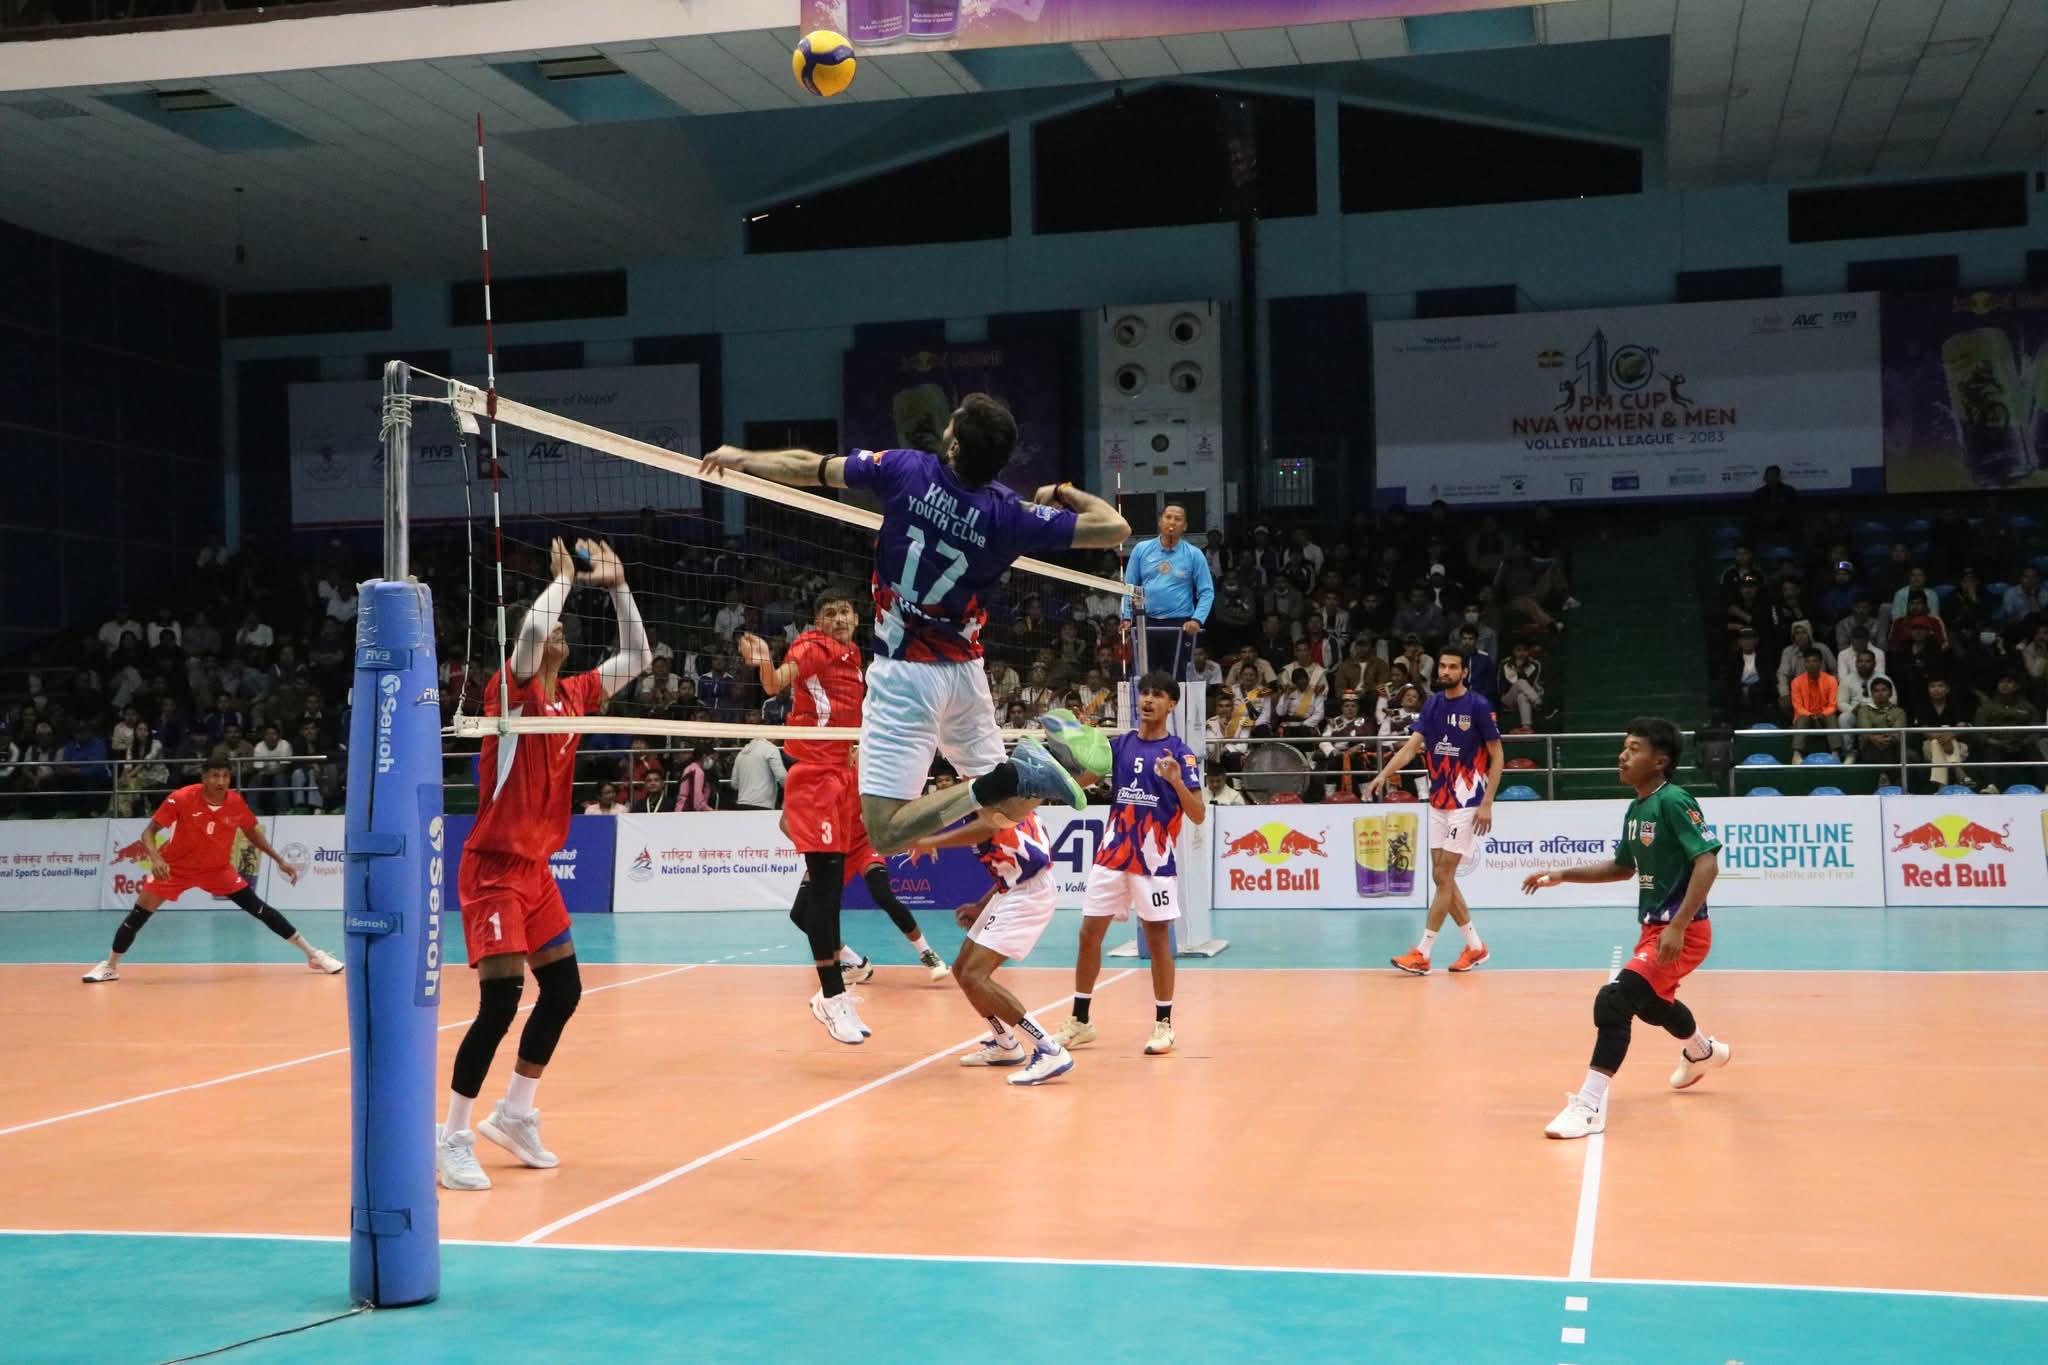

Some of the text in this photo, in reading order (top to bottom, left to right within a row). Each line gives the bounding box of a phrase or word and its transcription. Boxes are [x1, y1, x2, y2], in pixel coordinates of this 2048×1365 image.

[1580, 392, 1667, 412] PM CUP
[1512, 408, 1737, 434] NVA WOMEN & MEN
[1524, 436, 1615, 450] VOLLEYBALL
[1618, 432, 1674, 447] LEAGUE
[908, 495, 986, 548] YOUTH CLUB
[891, 524, 969, 606] 17
[1133, 757, 1145, 774] 5
[821, 821, 832, 845] 3
[1724, 823, 1854, 844] FRONTLINE
[1485, 837, 1533, 855] नेपाल
[1539, 835, 1605, 854] भलिबल
[1485, 857, 1517, 871] Nepal
[1519, 856, 1573, 871] Volleyball
[1725, 845, 1855, 868] HOSPITAL
[15, 868, 40, 879] Sports
[661, 865, 700, 875] National
[702, 864, 731, 876] Sports
[1230, 868, 1320, 891] Red Bull
[1763, 869, 1855, 881] Healthcare First
[1902, 864, 2007, 887] Red Bull
[890, 878, 931, 893] CAVA
[1152, 890, 1170, 907] 05
[424, 856, 443, 997] Senoh
[488, 912, 502, 941] 1
